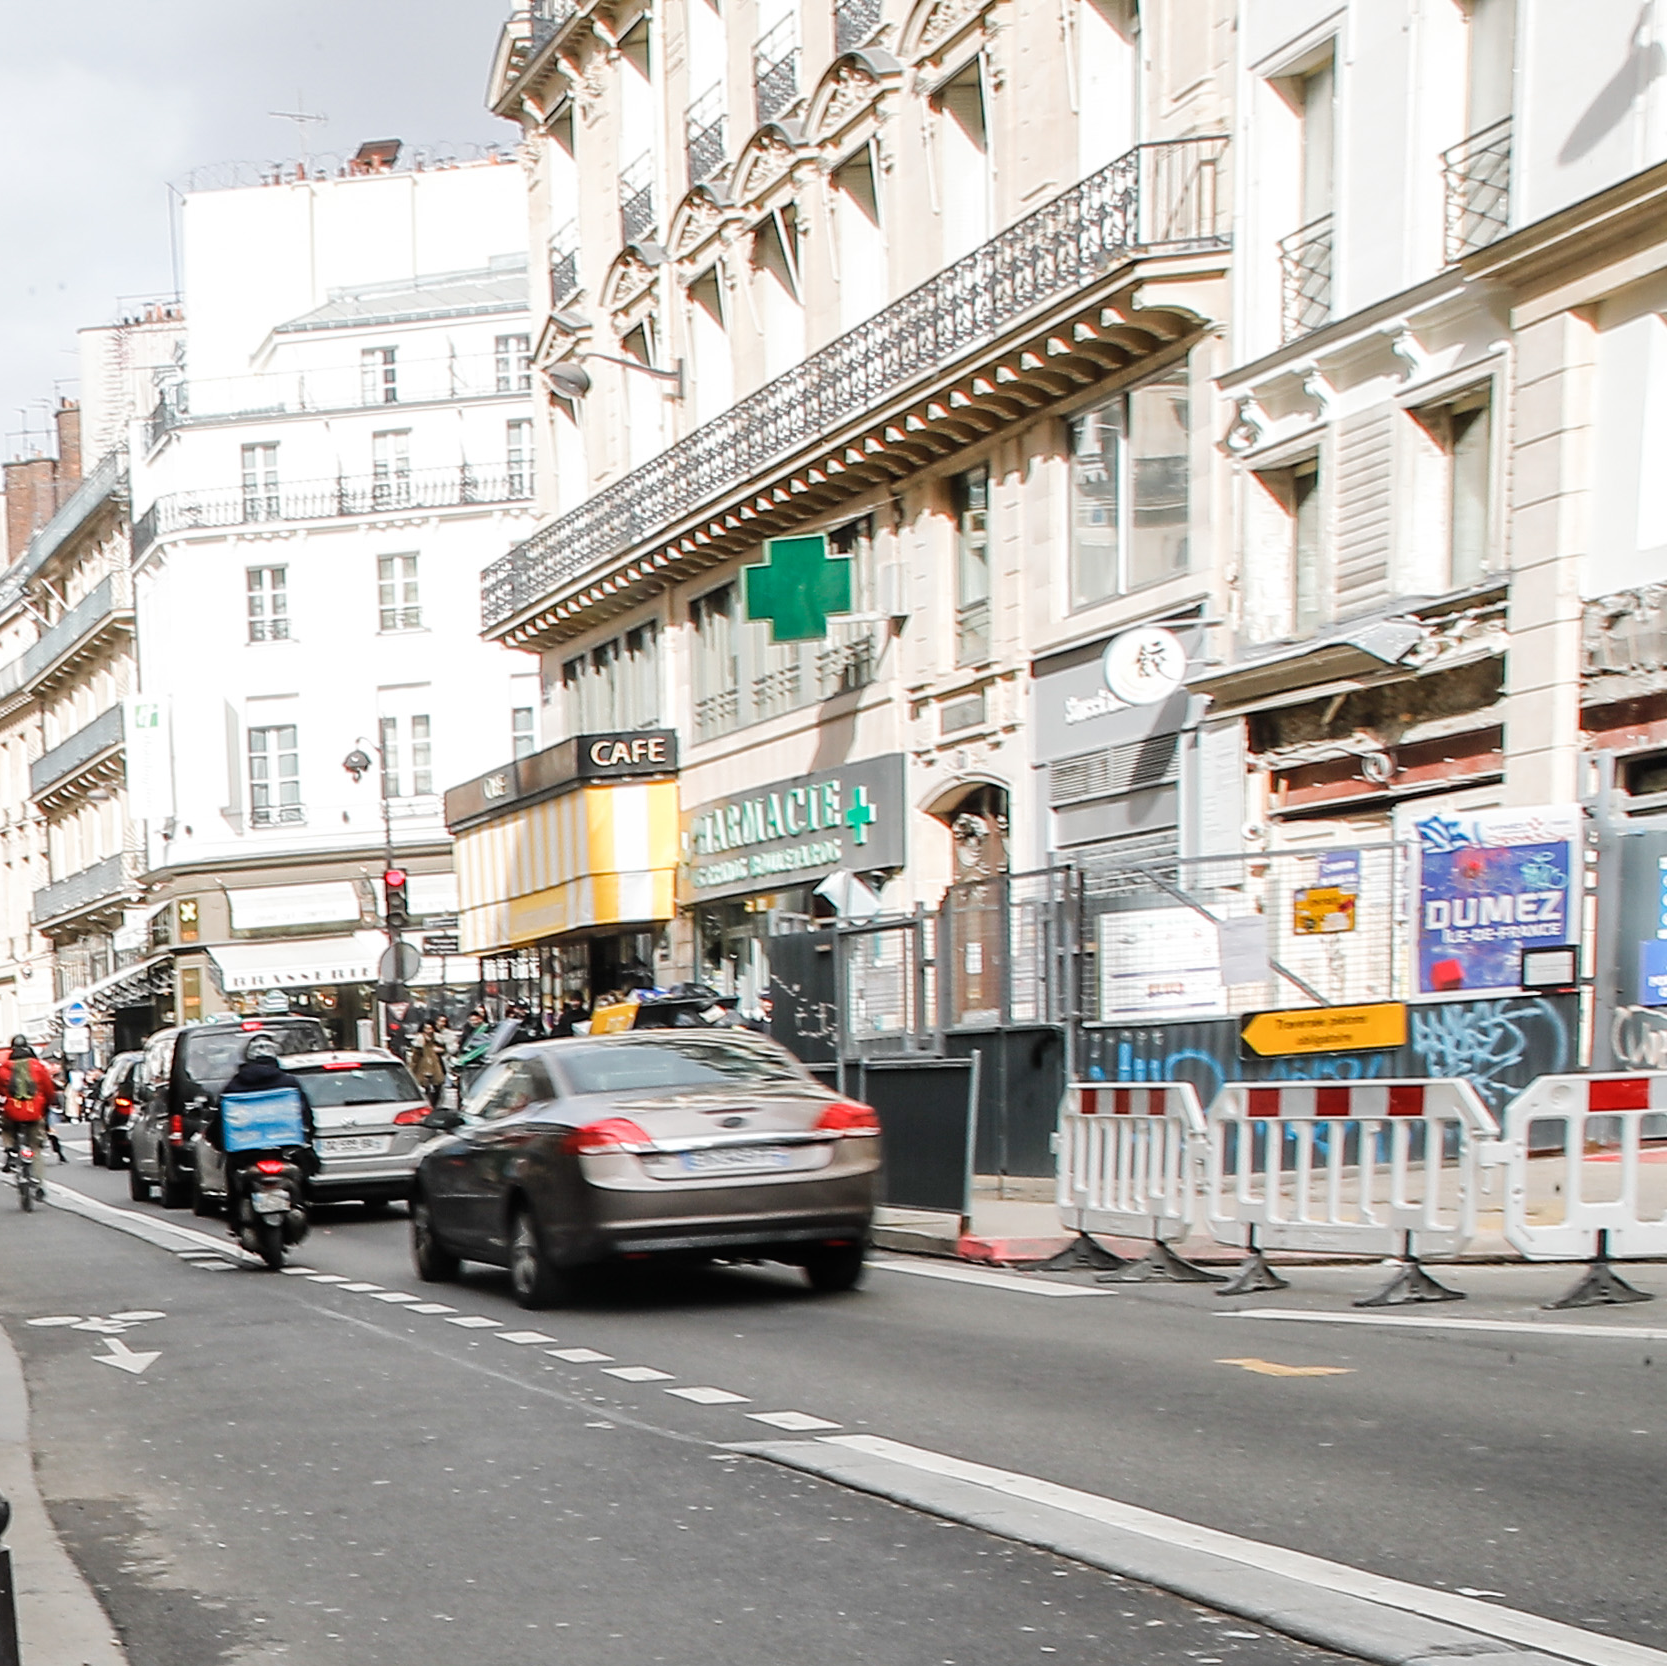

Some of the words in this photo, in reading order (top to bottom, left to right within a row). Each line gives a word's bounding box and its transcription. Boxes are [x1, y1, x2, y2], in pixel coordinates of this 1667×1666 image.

[589, 736, 667, 768] CAFE
[1424, 890, 1564, 930] DUMEZ
[232, 966, 375, 988] BRASSERIE
